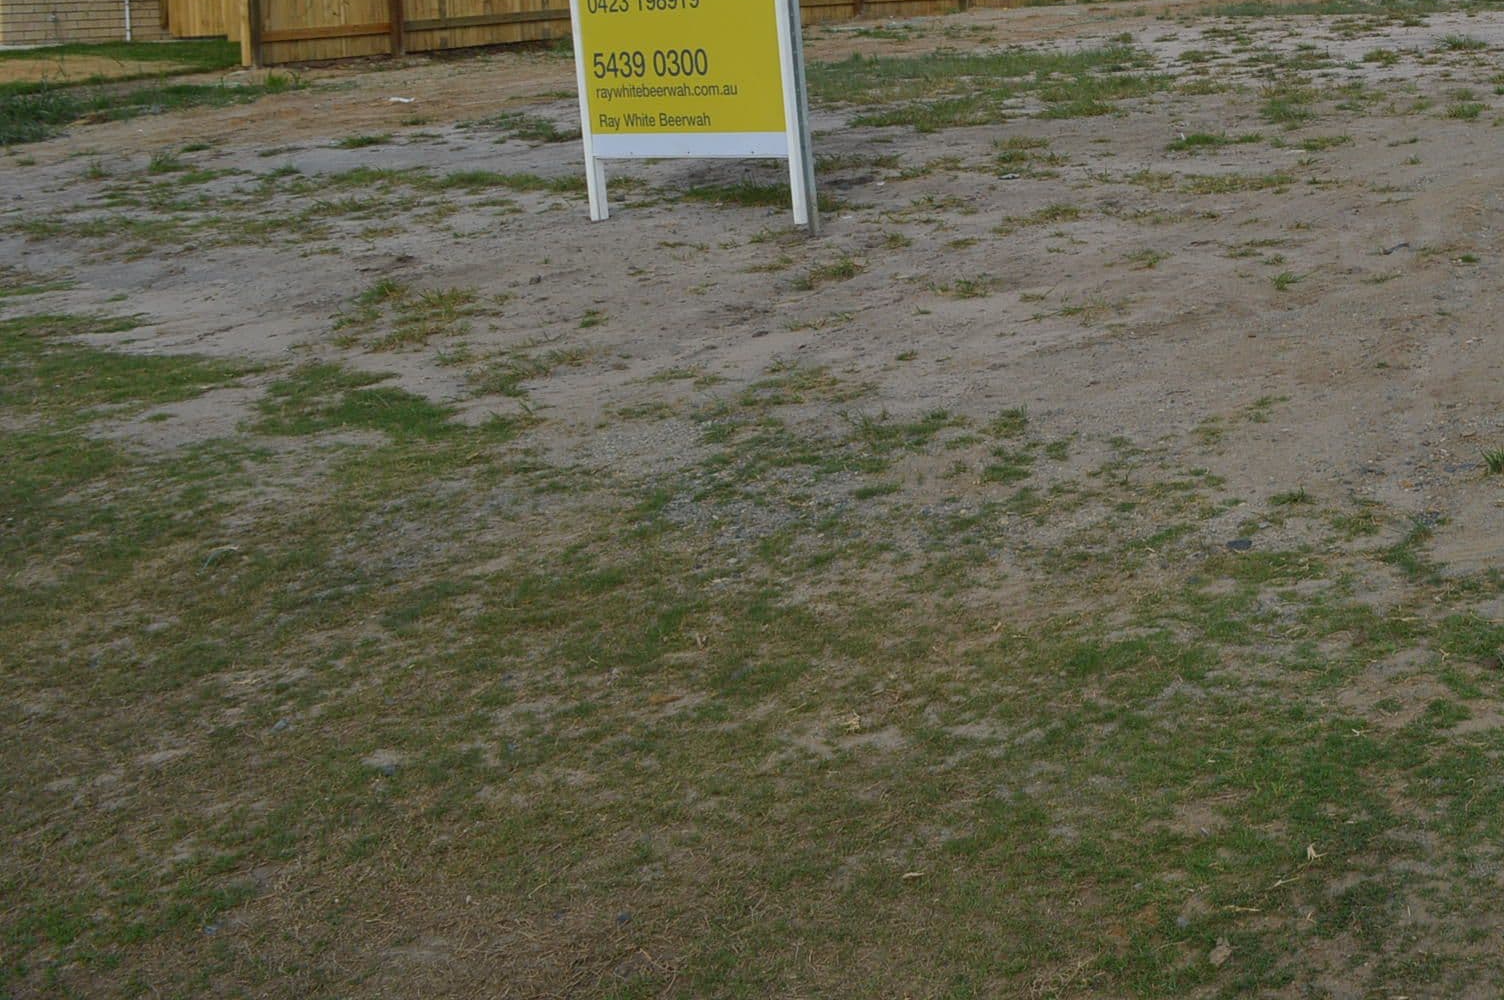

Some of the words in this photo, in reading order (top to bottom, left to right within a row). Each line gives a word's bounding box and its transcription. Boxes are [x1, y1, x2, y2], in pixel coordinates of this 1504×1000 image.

[593, 51, 646, 79] 5439
[653, 48, 709, 77] 0300
[596, 82, 739, 102] raywhitebeerwah.com.au
[599, 113, 621, 131] Ray
[623, 112, 656, 128] White
[659, 111, 712, 128] Beerwah
